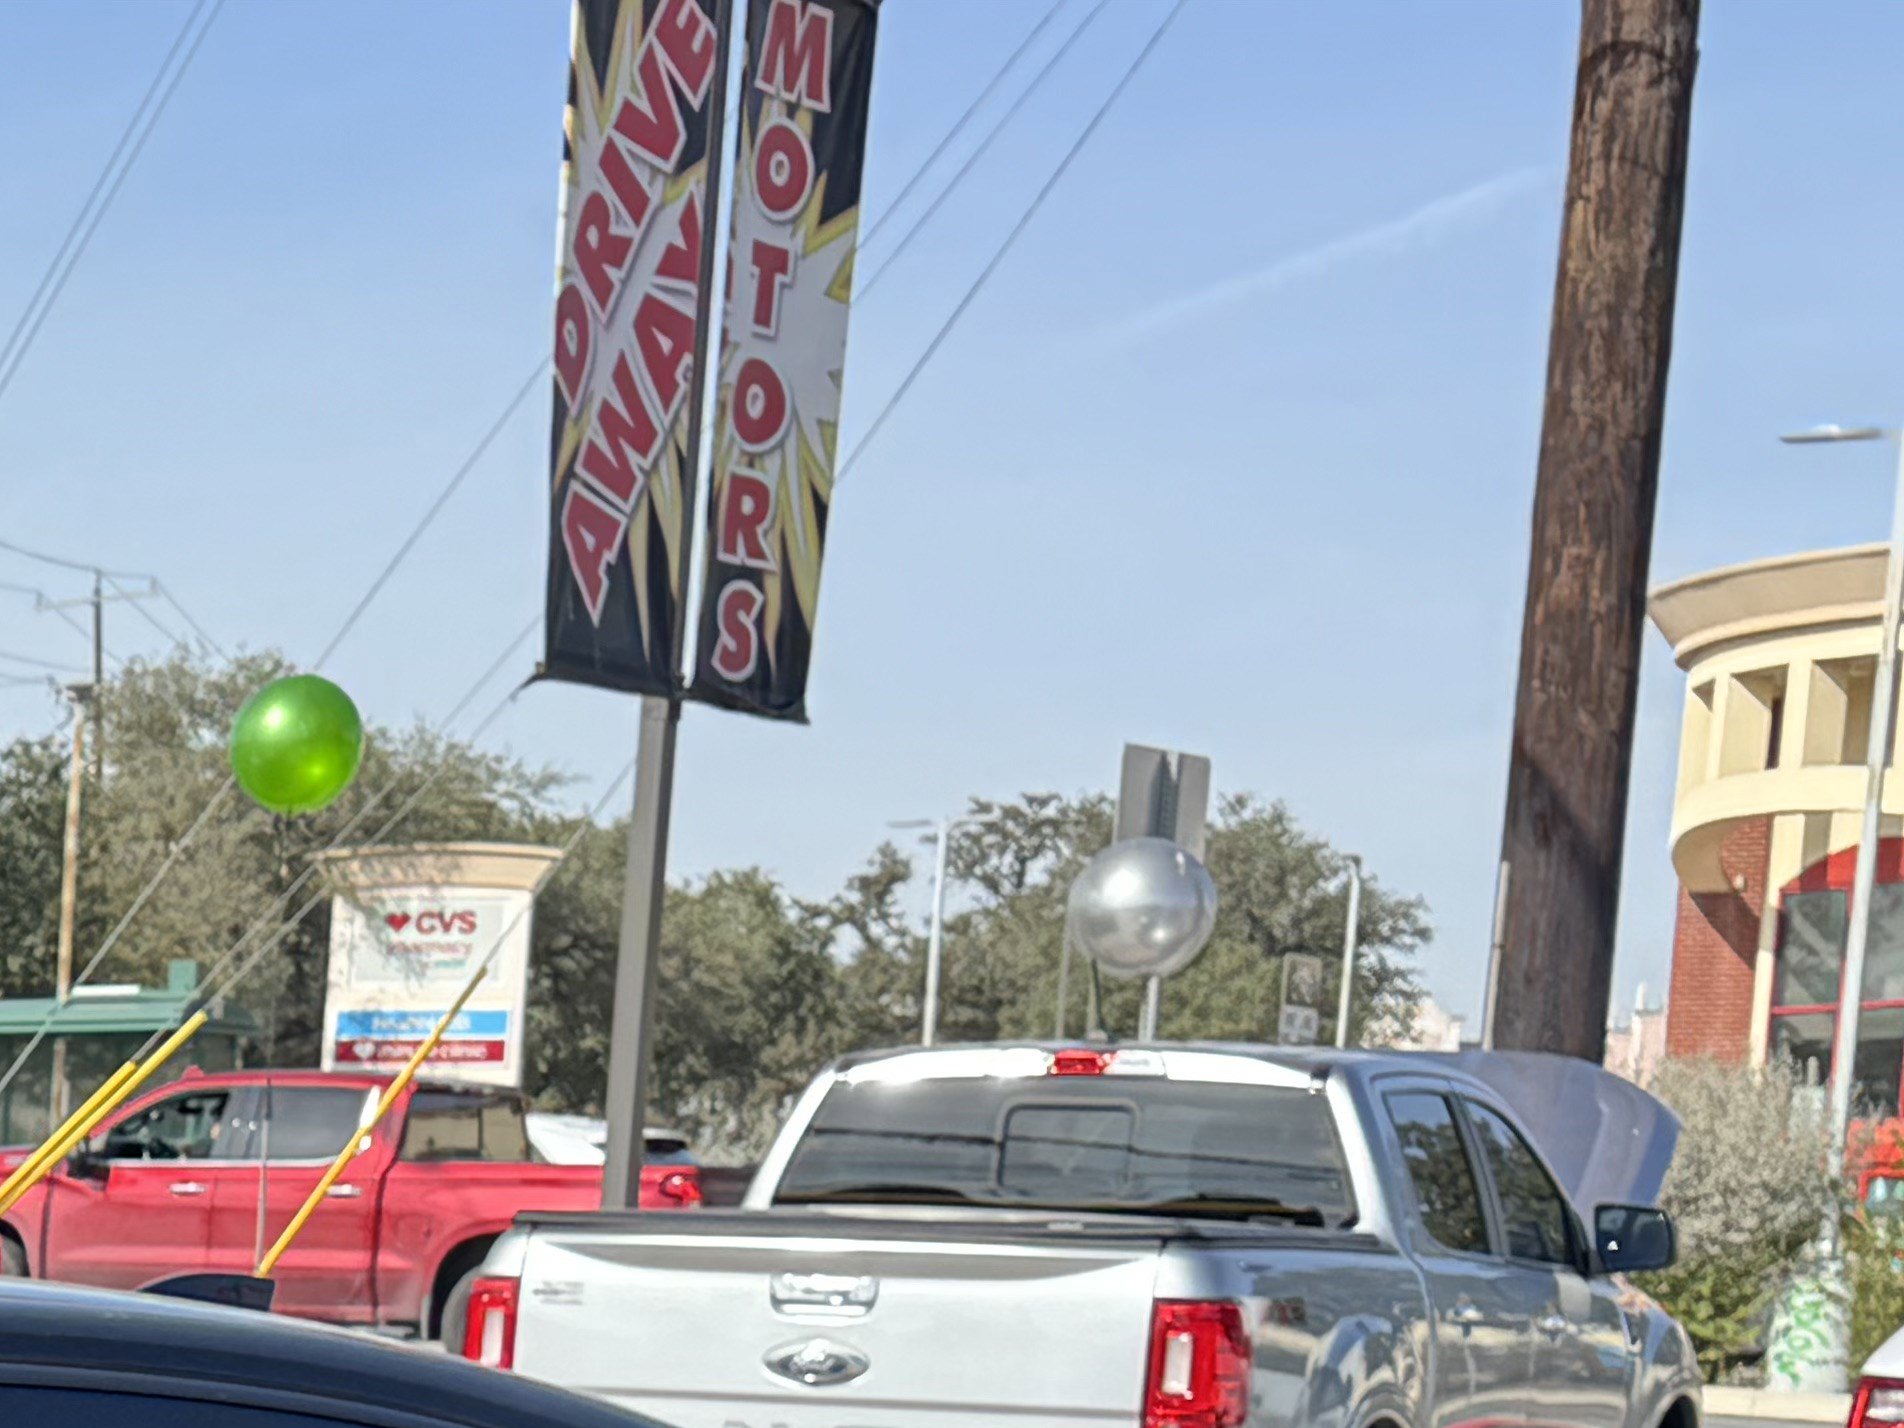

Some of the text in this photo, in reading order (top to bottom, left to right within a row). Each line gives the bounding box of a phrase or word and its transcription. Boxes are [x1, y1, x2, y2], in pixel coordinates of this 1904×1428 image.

[553, 0, 718, 416] DRIVE
[711, 0, 833, 682] MOTORS
[415, 911, 477, 934] CVS
